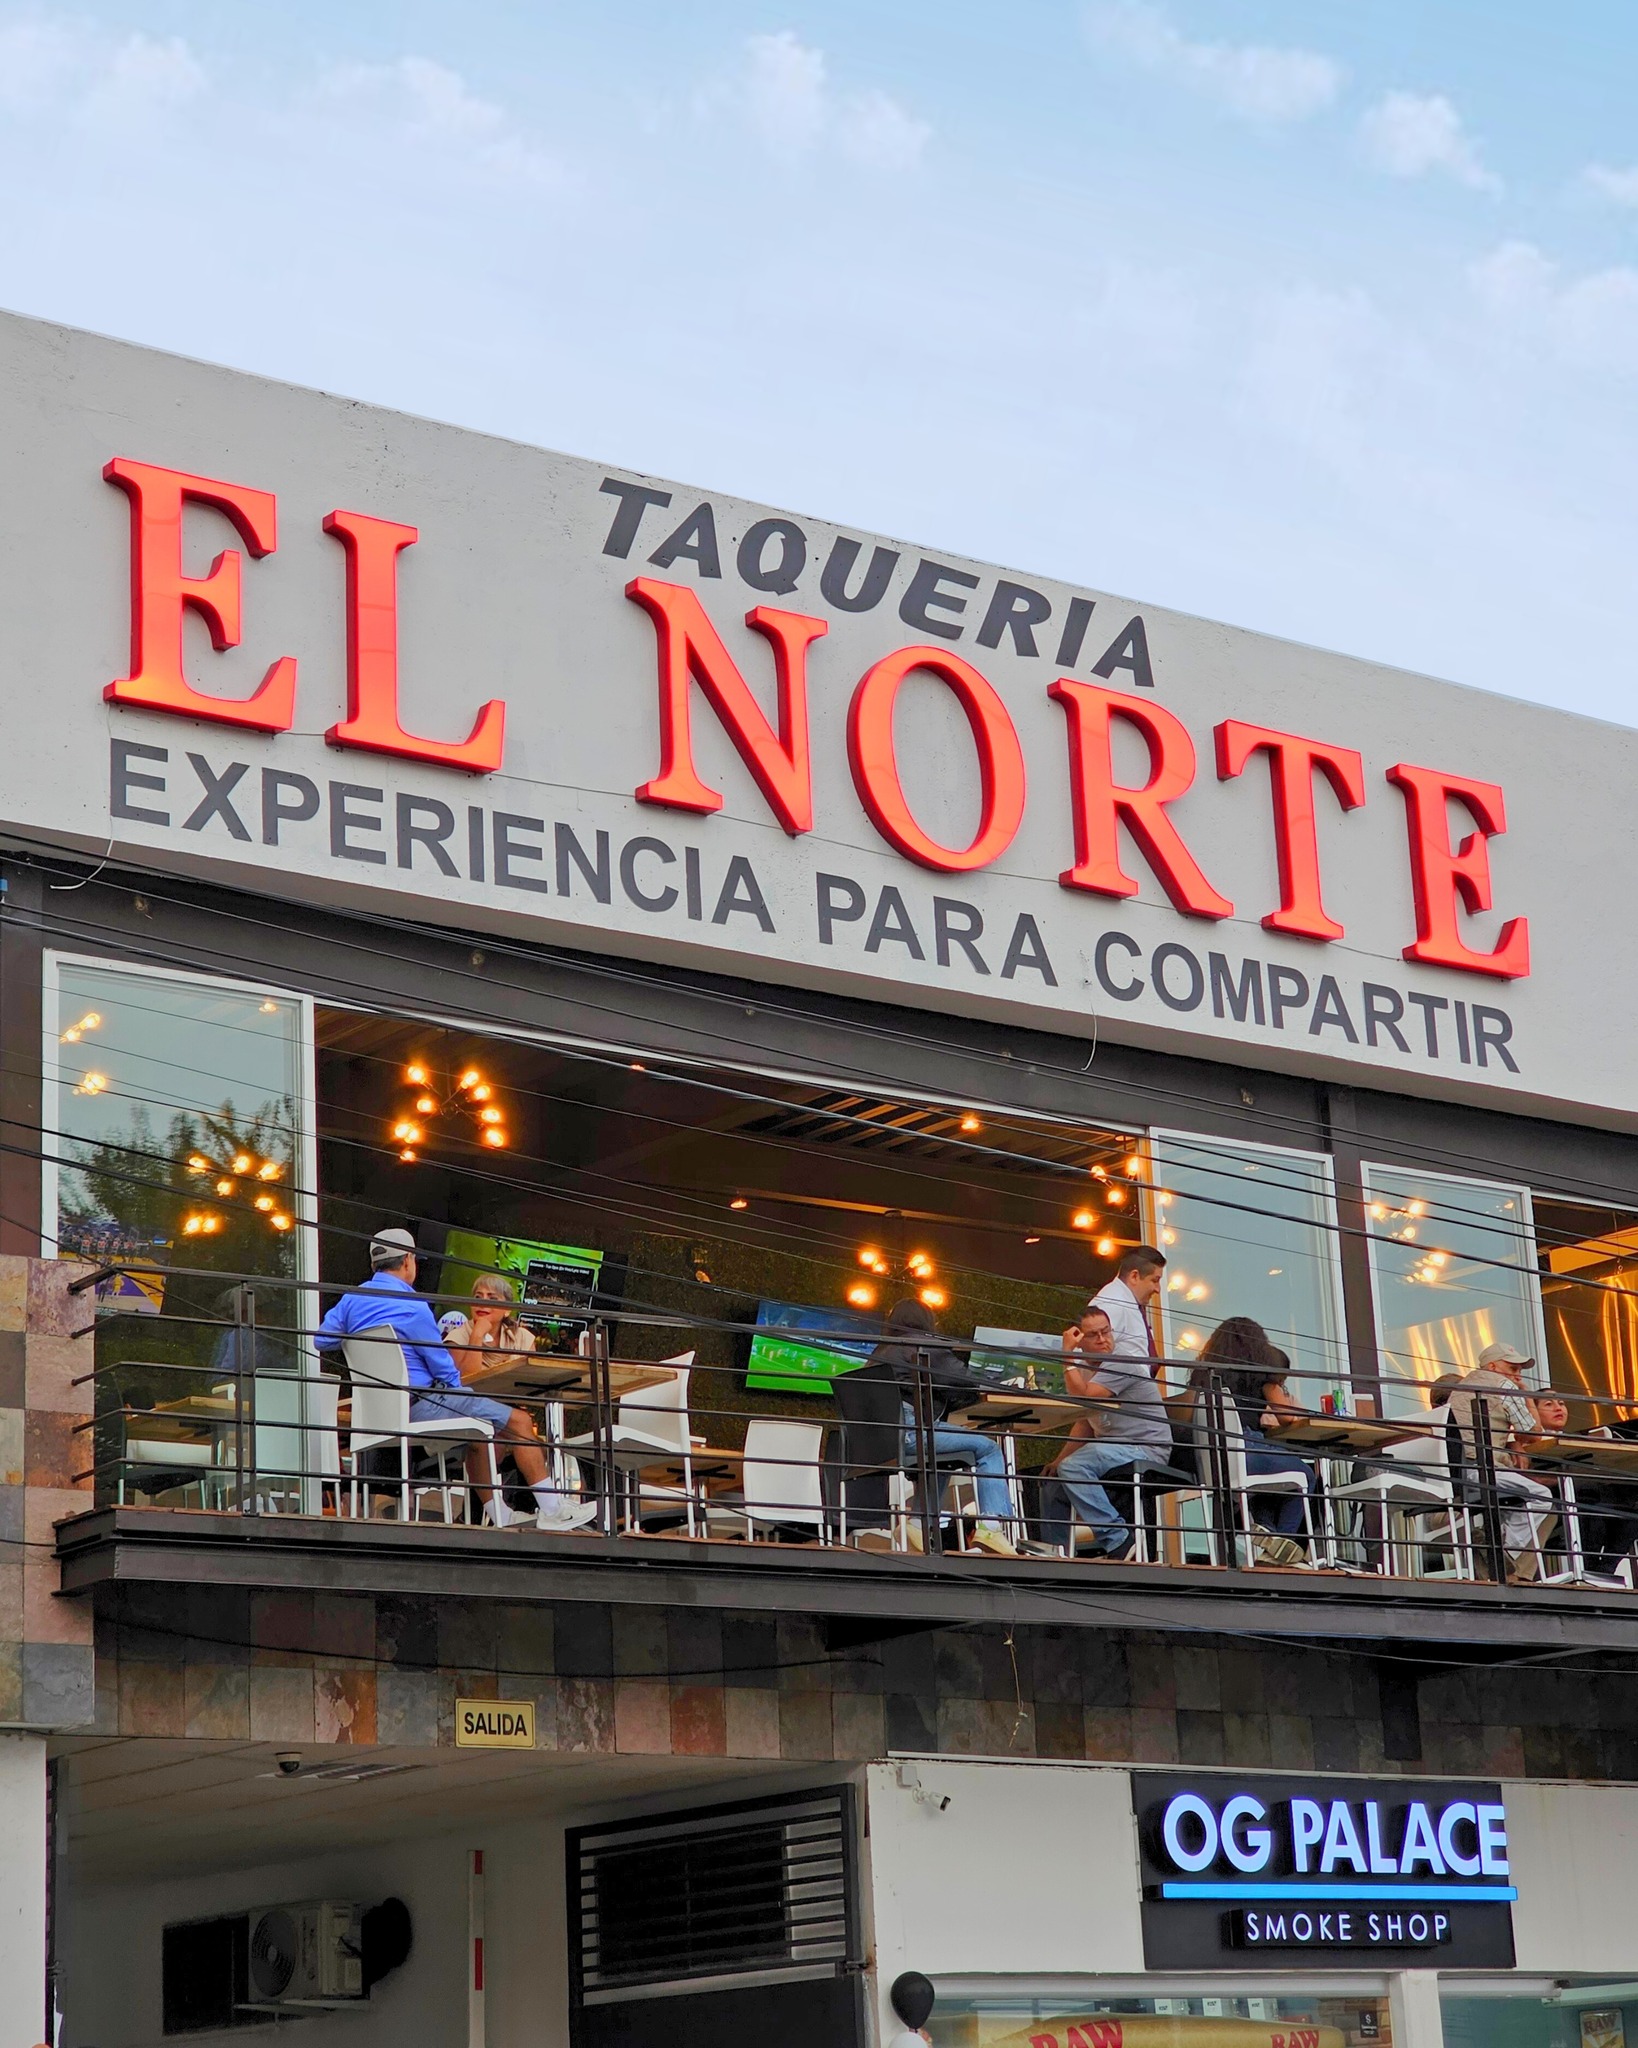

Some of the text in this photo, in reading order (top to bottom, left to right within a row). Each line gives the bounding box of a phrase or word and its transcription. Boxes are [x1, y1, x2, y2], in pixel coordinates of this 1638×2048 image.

[599, 477, 1155, 688] TAQUERIA
[103, 456, 1530, 980] EL NORTE
[110, 738, 1521, 1074] EXPERIENCIA PARA COMPARTIR
[463, 1711, 528, 1737] SALIDA
[1163, 1793, 1511, 1876] OG PALACE
[1246, 1912, 1449, 1942] SMOKE SHOP
